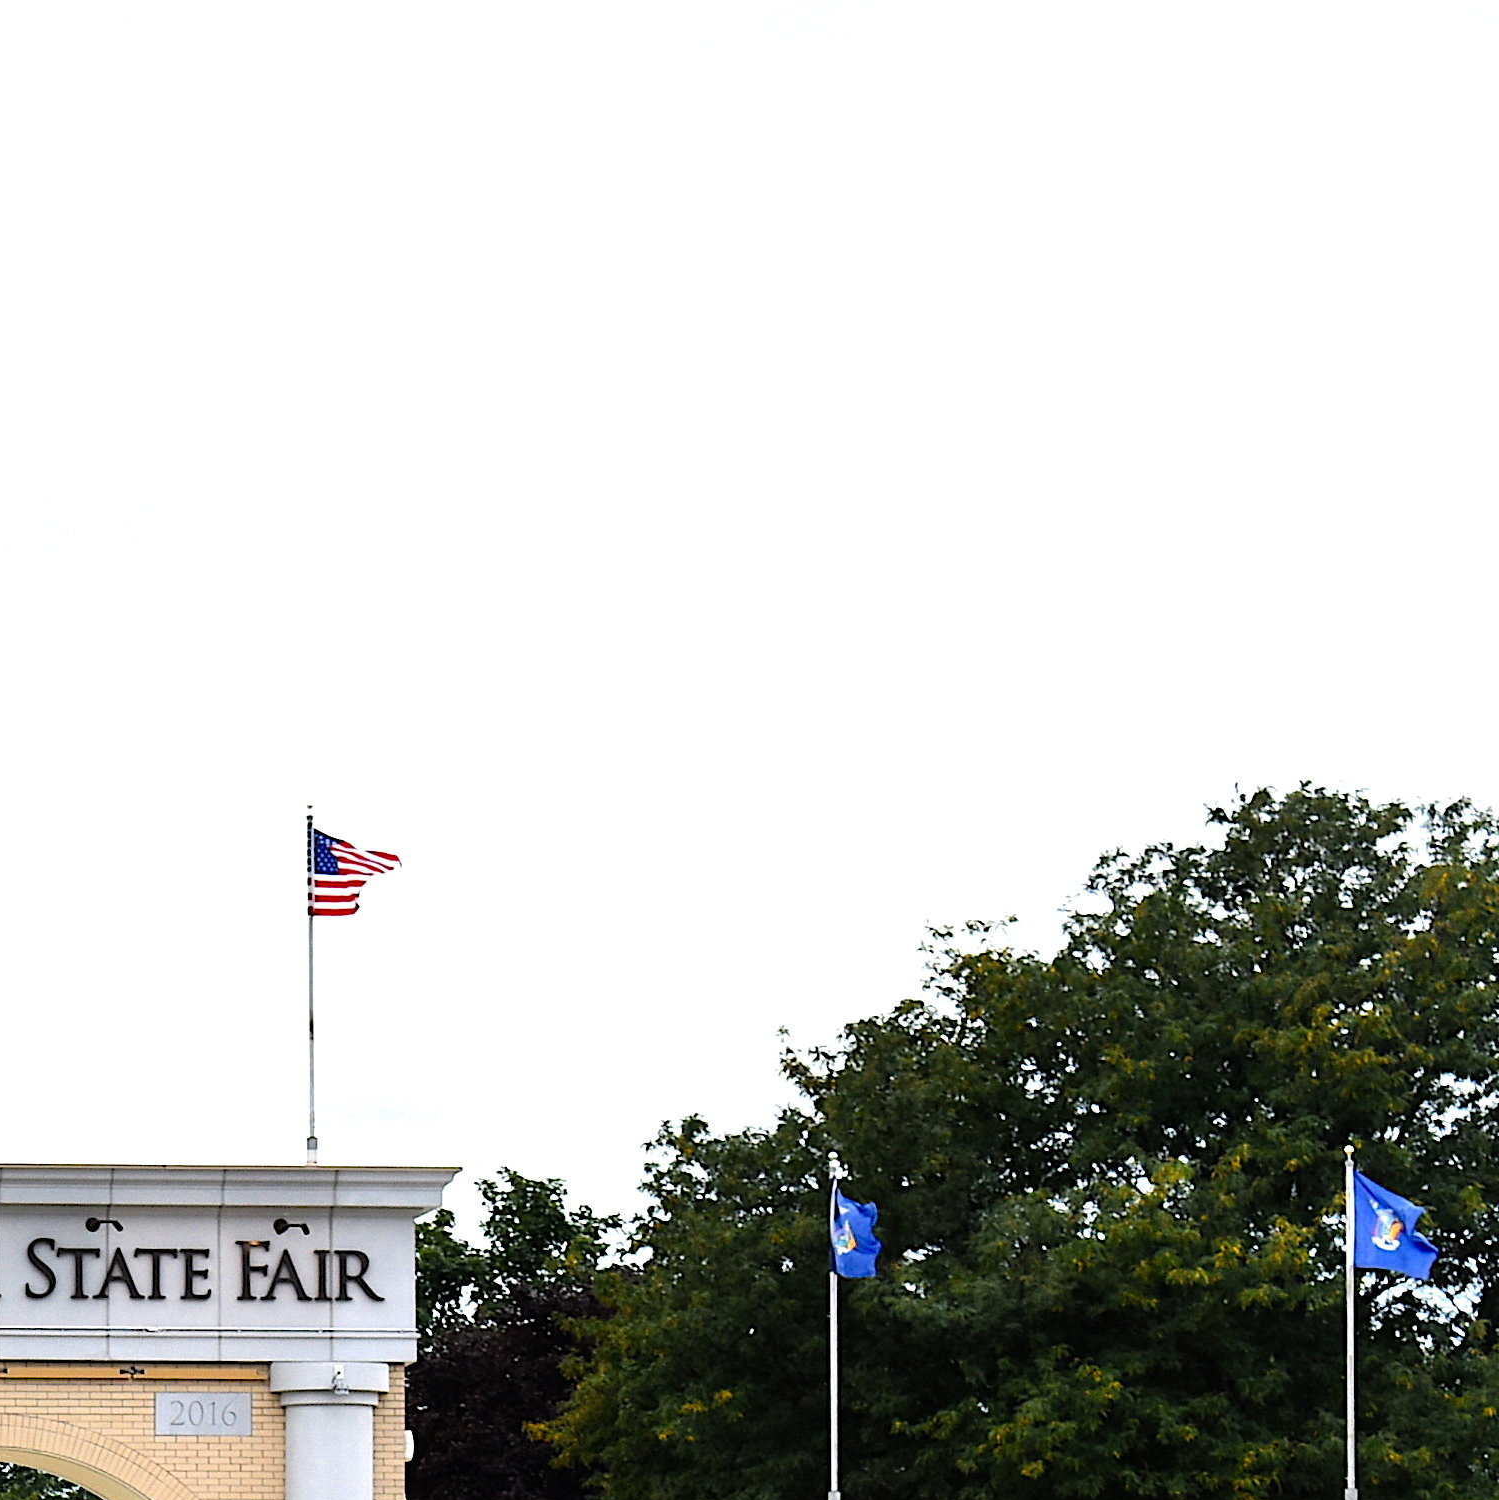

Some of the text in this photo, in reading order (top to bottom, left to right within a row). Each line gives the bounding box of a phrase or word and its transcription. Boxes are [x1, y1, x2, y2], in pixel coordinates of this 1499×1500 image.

[25, 1237, 212, 1301] STATE
[235, 1240, 386, 1302] FAIR
[169, 1400, 238, 1427] 2016
